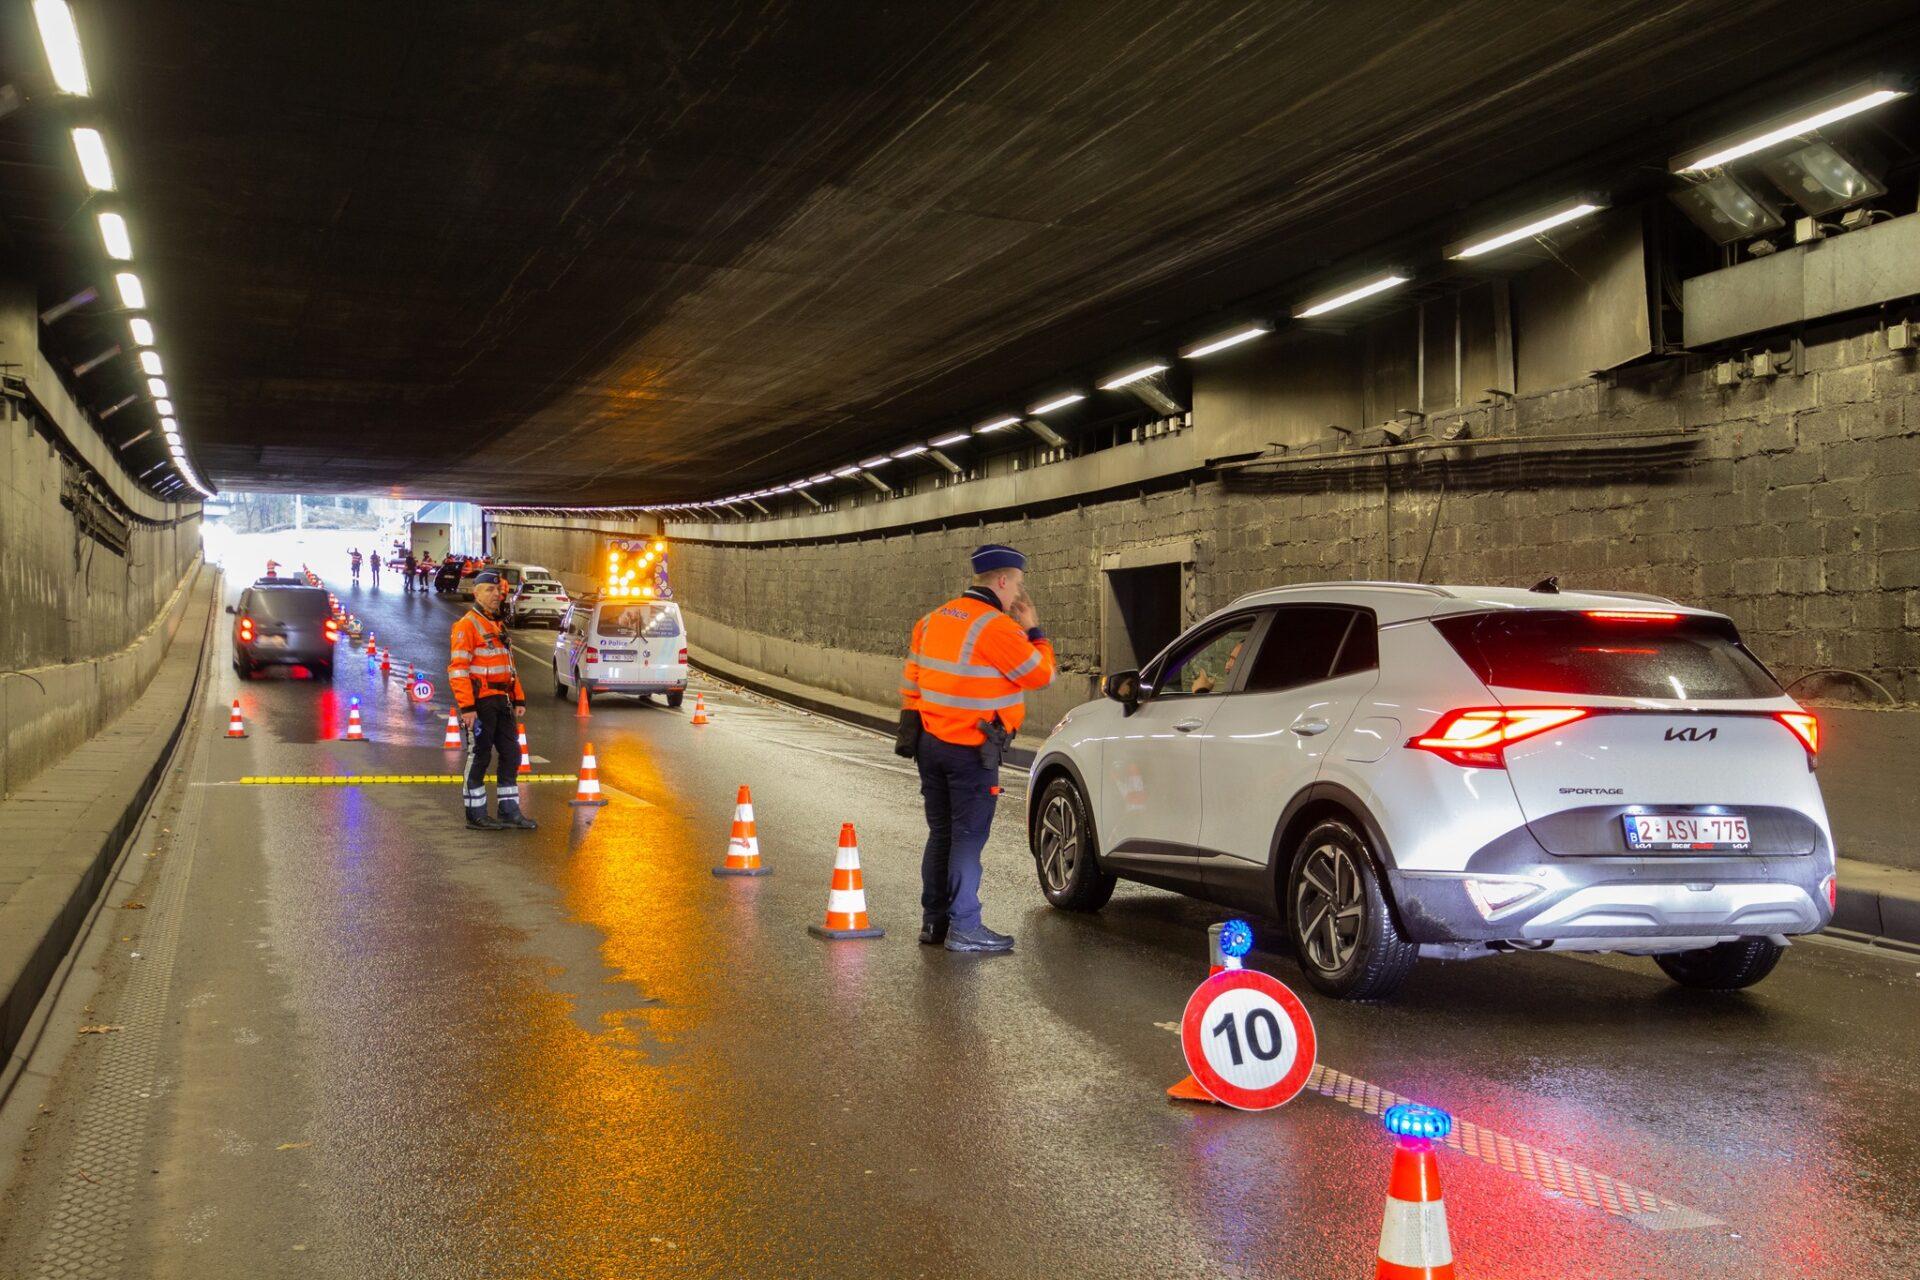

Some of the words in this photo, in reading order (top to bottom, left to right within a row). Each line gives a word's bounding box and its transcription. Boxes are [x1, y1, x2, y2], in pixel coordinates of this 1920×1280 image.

[416, 686, 428, 695] 10
[1664, 727, 1717, 741] KIA
[1559, 787, 1624, 795] SPORTAGE
[1630, 832, 1638, 842] B
[1212, 1008, 1283, 1066] 10
